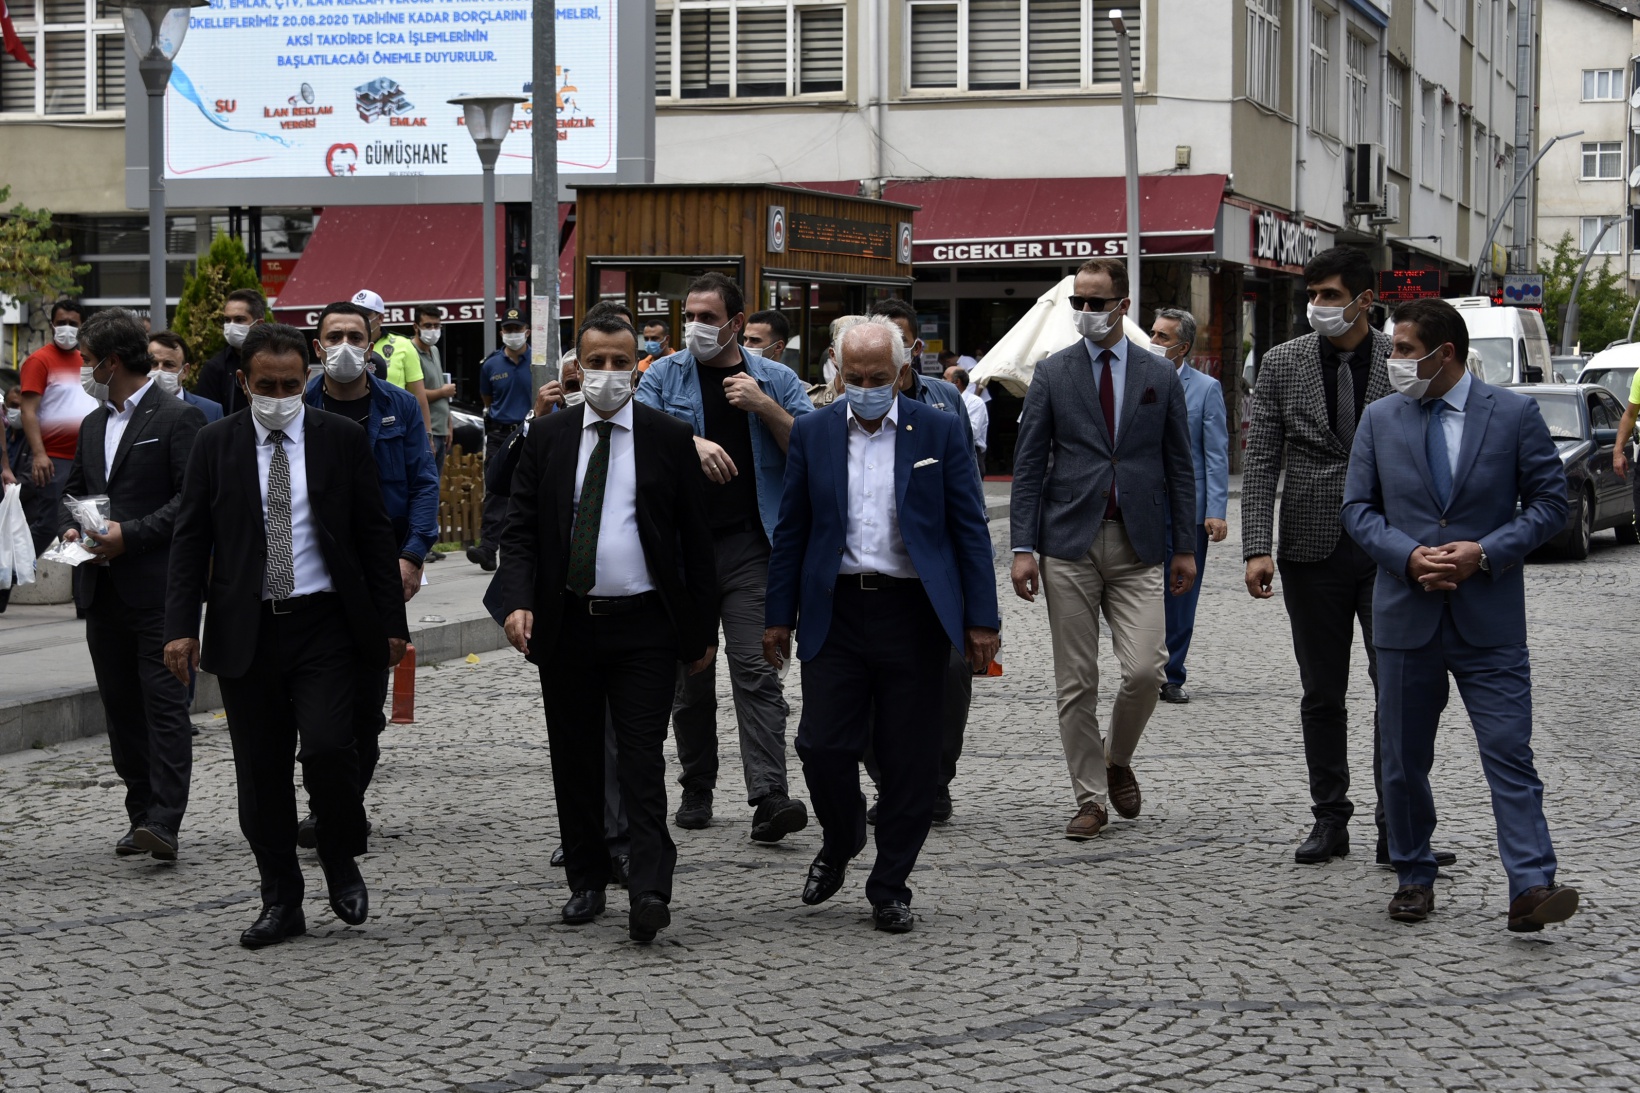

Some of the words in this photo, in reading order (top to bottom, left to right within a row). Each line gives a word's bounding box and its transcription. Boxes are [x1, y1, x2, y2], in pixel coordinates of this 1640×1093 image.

[189, 15, 279, 29] ÜKELLEFLERİMİZ
[283, 15, 349, 27] 20.08.2020
[353, 11, 405, 25] TARİHİNE
[408, 12, 449, 23] KADAR
[453, 10, 527, 24] BORÇLARINI
[531, 6, 601, 20] MELERİ,
[286, 32, 313, 46] AKSİ
[317, 32, 373, 46] TAKDİRDE
[376, 31, 405, 45] İCRA
[409, 28, 488, 45] İŞLEMLERİNİN
[277, 51, 369, 68] BAŞLATILACAĞI
[373, 51, 421, 64] ÖNEMLE
[425, 51, 497, 63] DUYURULUR.
[215, 99, 237, 113] SU
[263, 106, 289, 118] İLAN
[292, 105, 333, 117] REKLAM
[280, 118, 316, 130] VERGİSİ
[389, 116, 427, 127] EMLAK
[509, 120, 532, 133] ÇEV
[556, 116, 595, 129] EMİZLİK
[365, 139, 448, 169] GÜMÜŞHANE
[1048, 240, 1099, 256] LTD.
[1103, 239, 1147, 255] ST.
[459, 304, 498, 319] ST.
